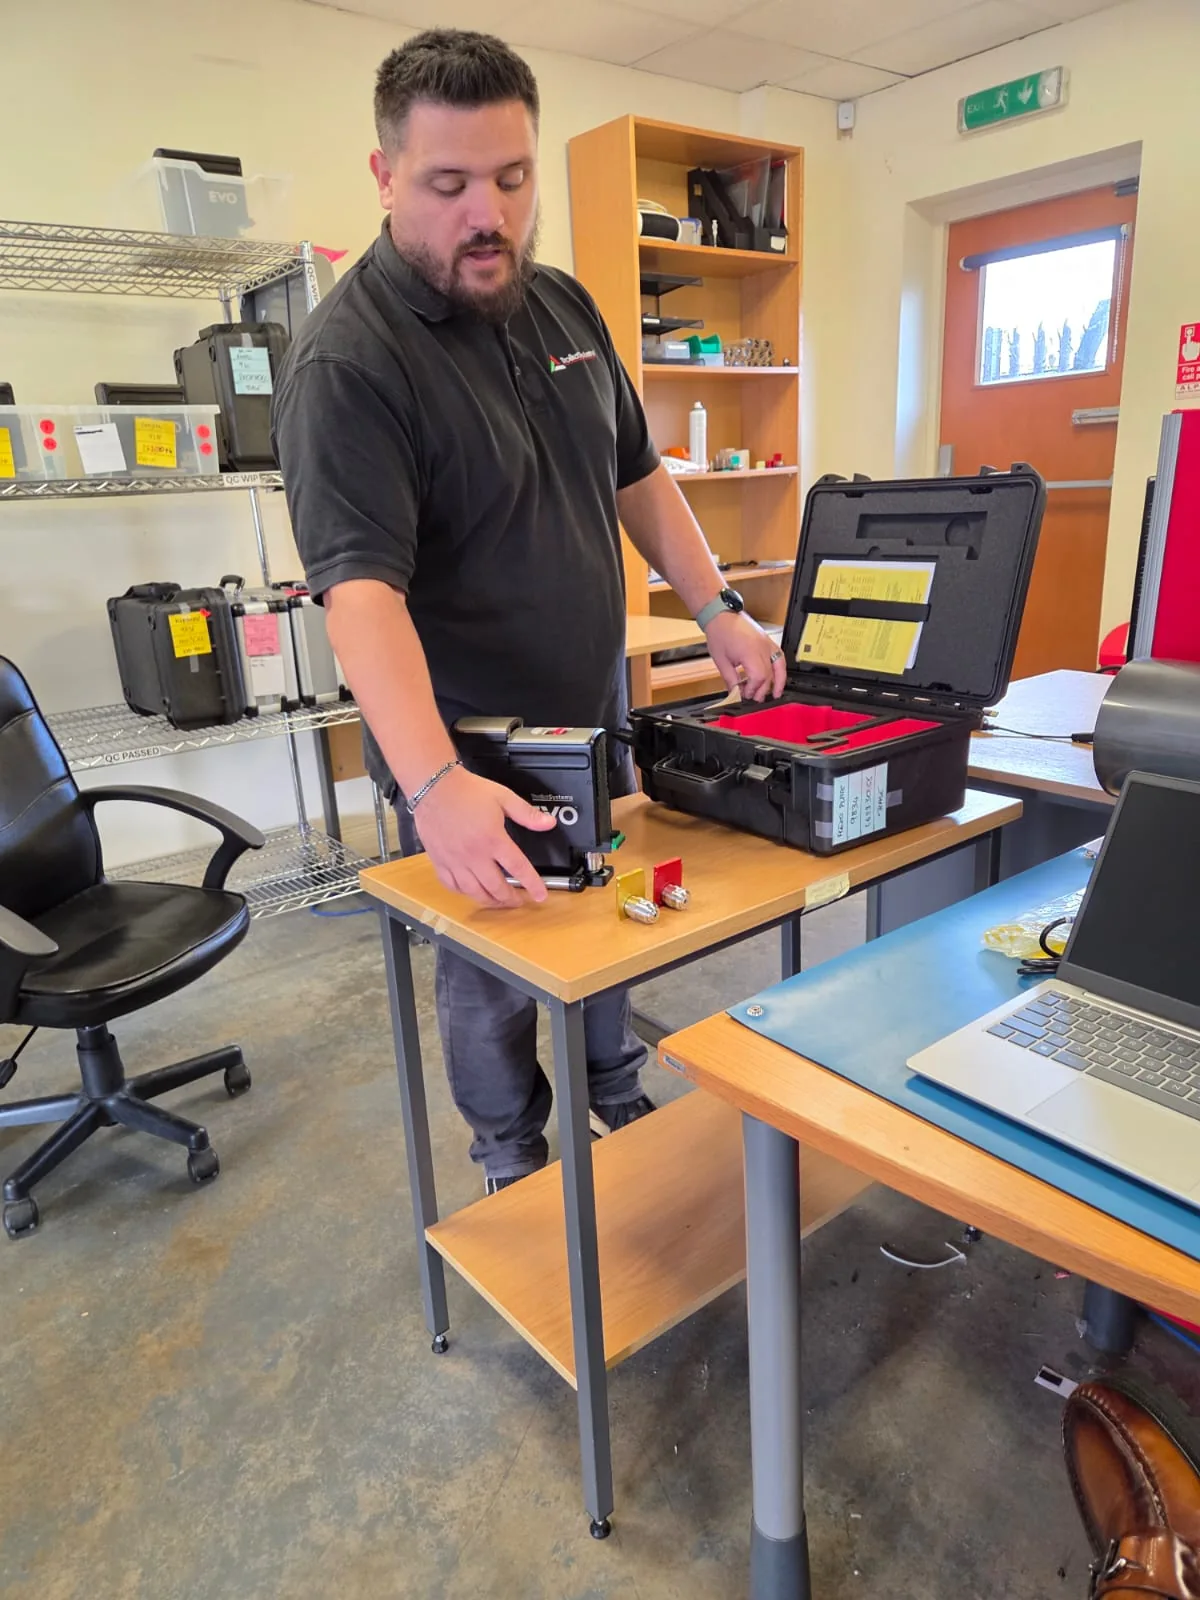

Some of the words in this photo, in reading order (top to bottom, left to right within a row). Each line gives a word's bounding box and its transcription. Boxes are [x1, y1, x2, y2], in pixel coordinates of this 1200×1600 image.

[208, 190, 238, 205] EVO
[1181, 366, 1195, 374] Fire
[225, 475, 240, 485] QC
[241, 474, 259, 483] WIP
[105, 753, 121, 763] QC
[122, 747, 160, 760] PASSED
[532, 805, 579, 825] VO
